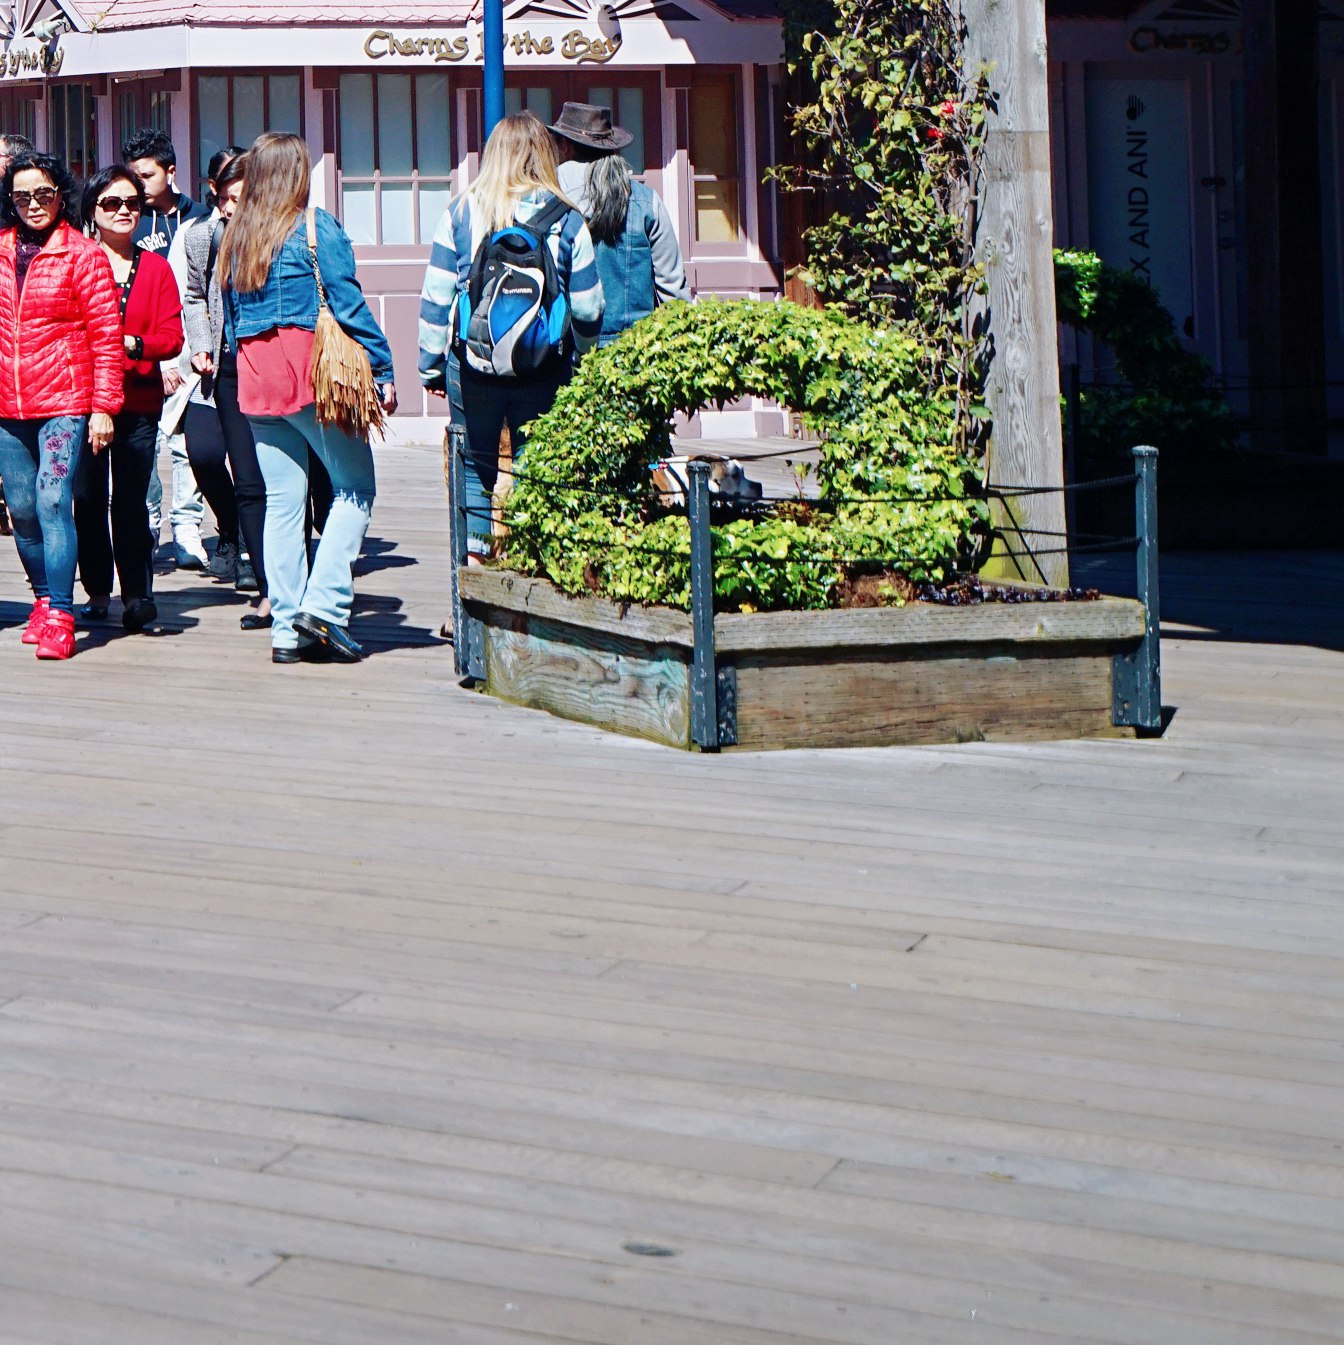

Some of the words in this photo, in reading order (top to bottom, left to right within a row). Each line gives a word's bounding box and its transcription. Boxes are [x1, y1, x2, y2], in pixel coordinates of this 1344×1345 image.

[363, 30, 468, 62] Charms
[511, 30, 554, 56] the
[561, 29, 622, 64] Bay
[1129, 186, 1150, 248] AND
